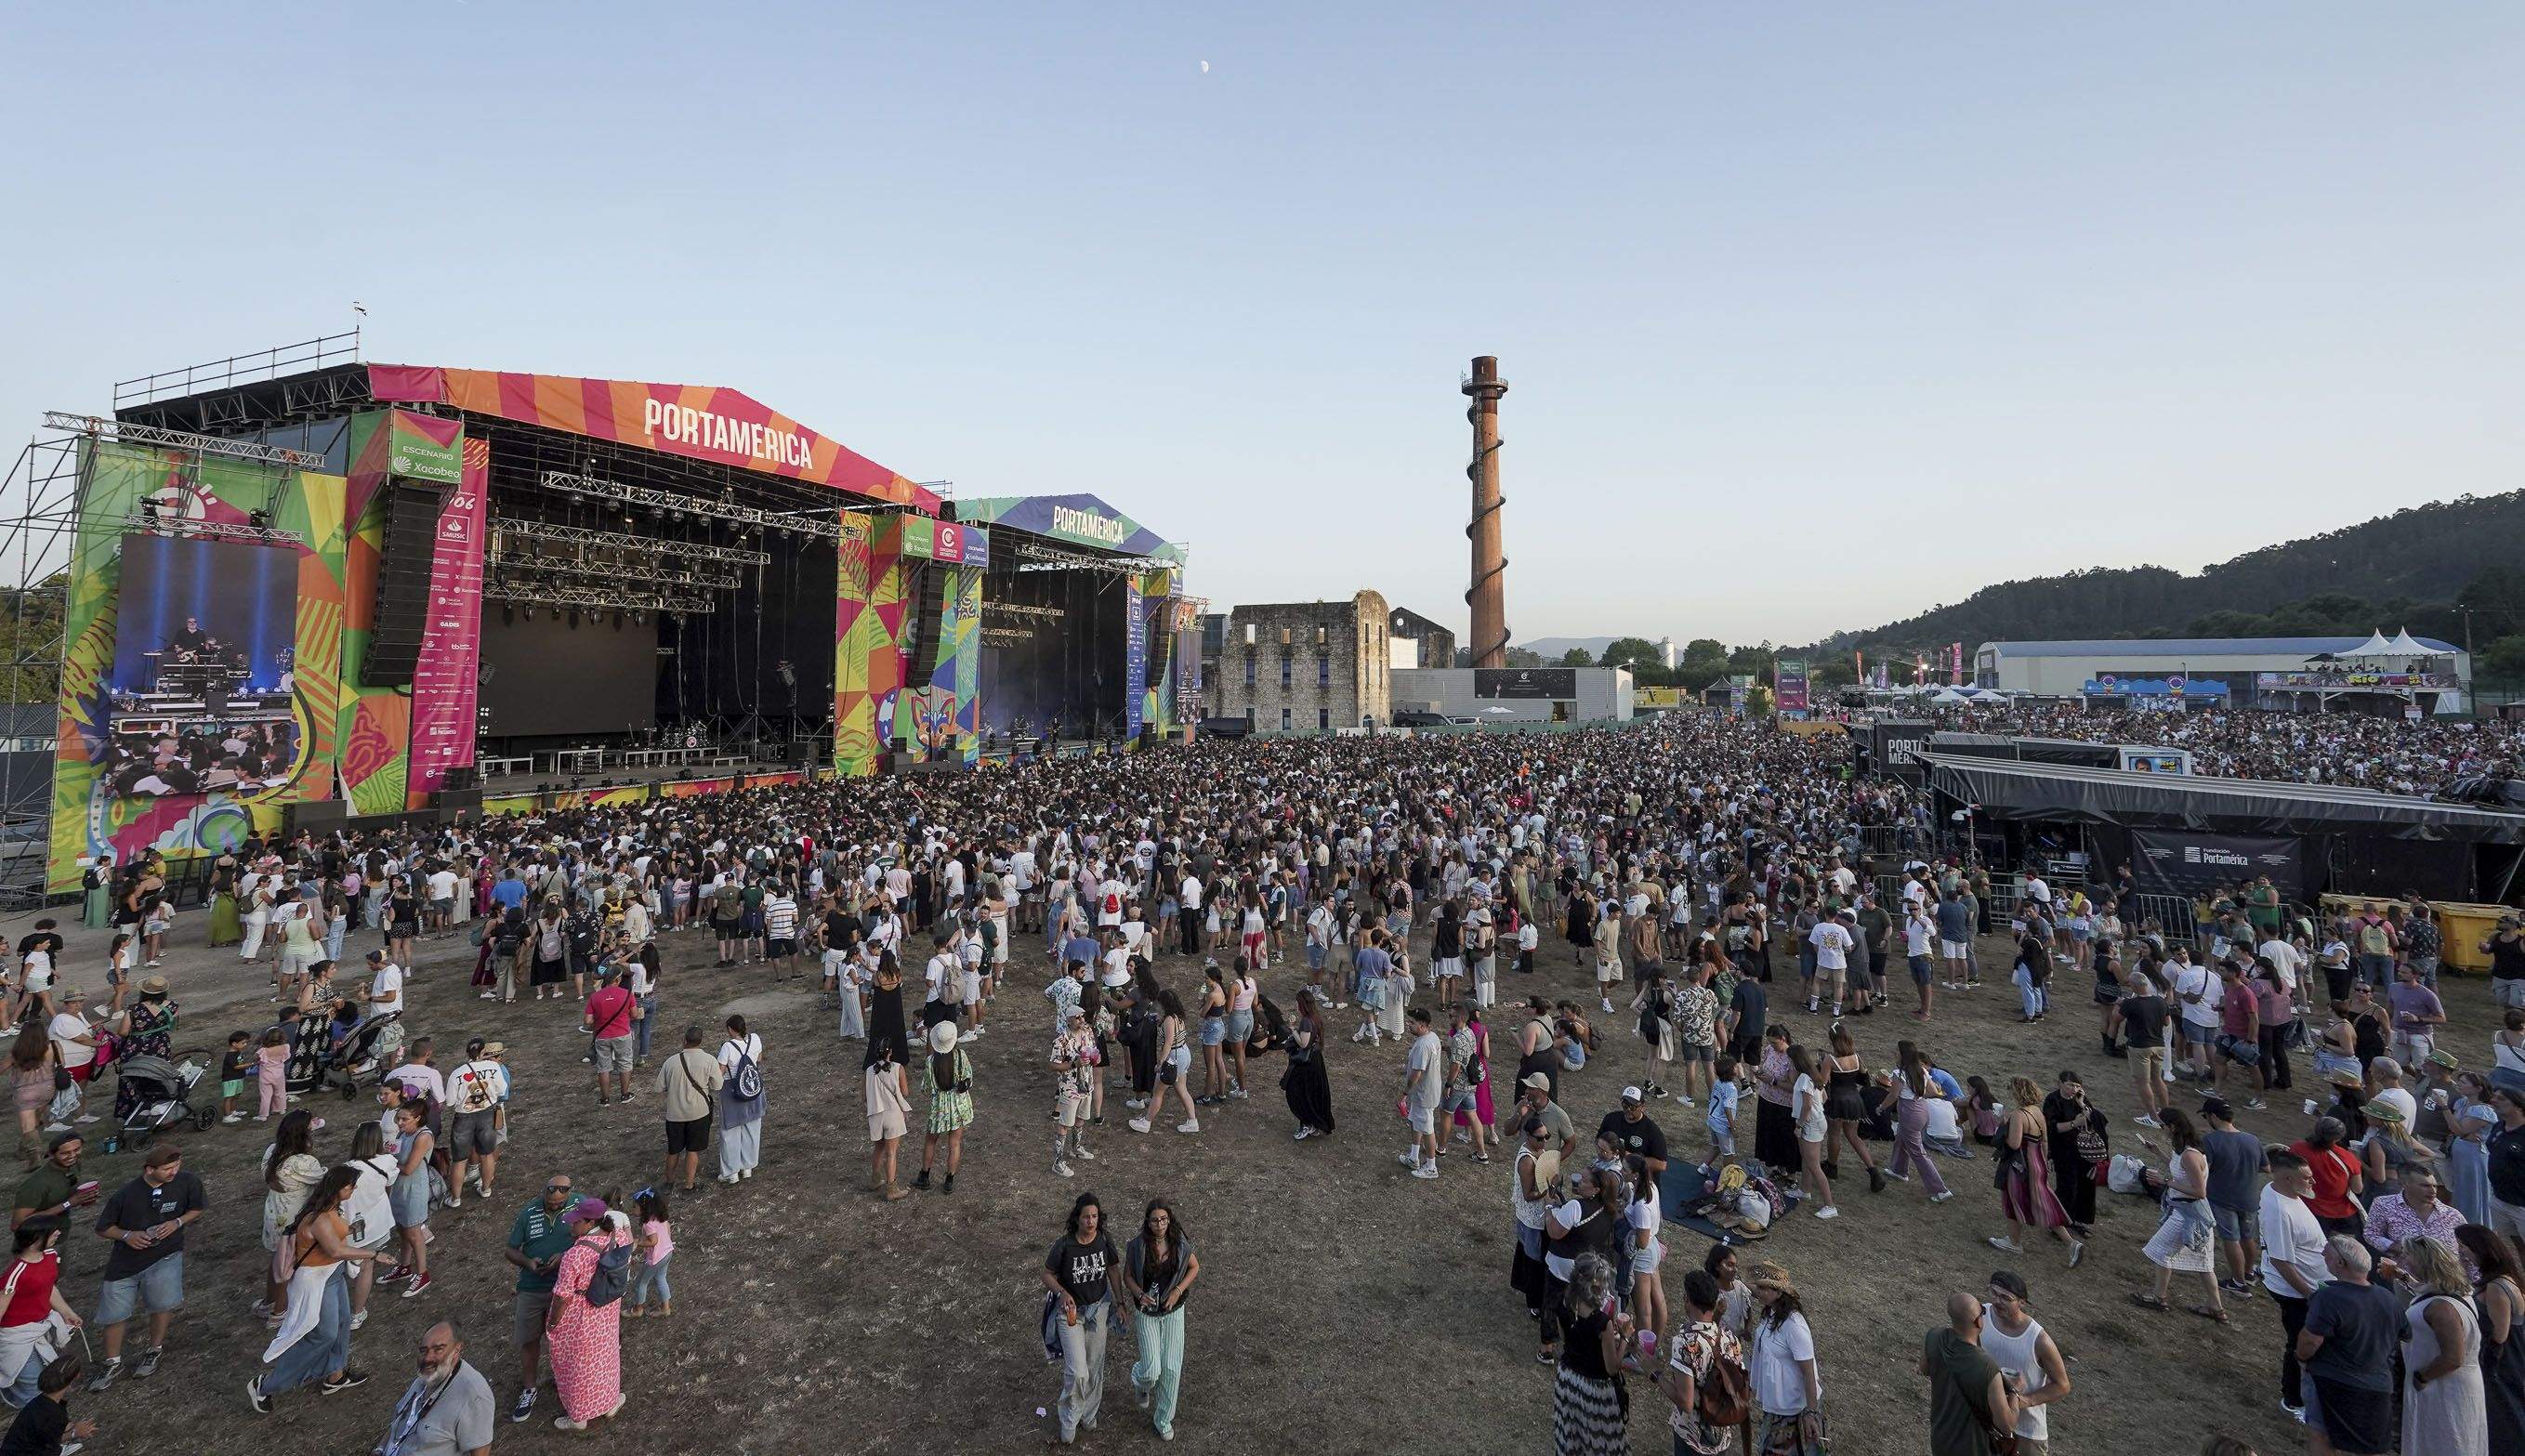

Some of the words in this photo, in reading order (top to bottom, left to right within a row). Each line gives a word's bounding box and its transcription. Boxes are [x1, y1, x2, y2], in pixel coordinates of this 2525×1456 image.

[644, 398, 813, 469] PORTAMÉRICA
[402, 446, 454, 461] ESCENARIO
[414, 463, 461, 479] Xacobeo
[1053, 505, 1124, 544] PORTAMÉRICA
[441, 531, 466, 540] SMUSIC
[2203, 852, 2248, 866] Portamérica
[456, 1074, 464, 1086] I
[477, 1069, 498, 1080] NY
[1710, 1095, 1719, 1115] 7
